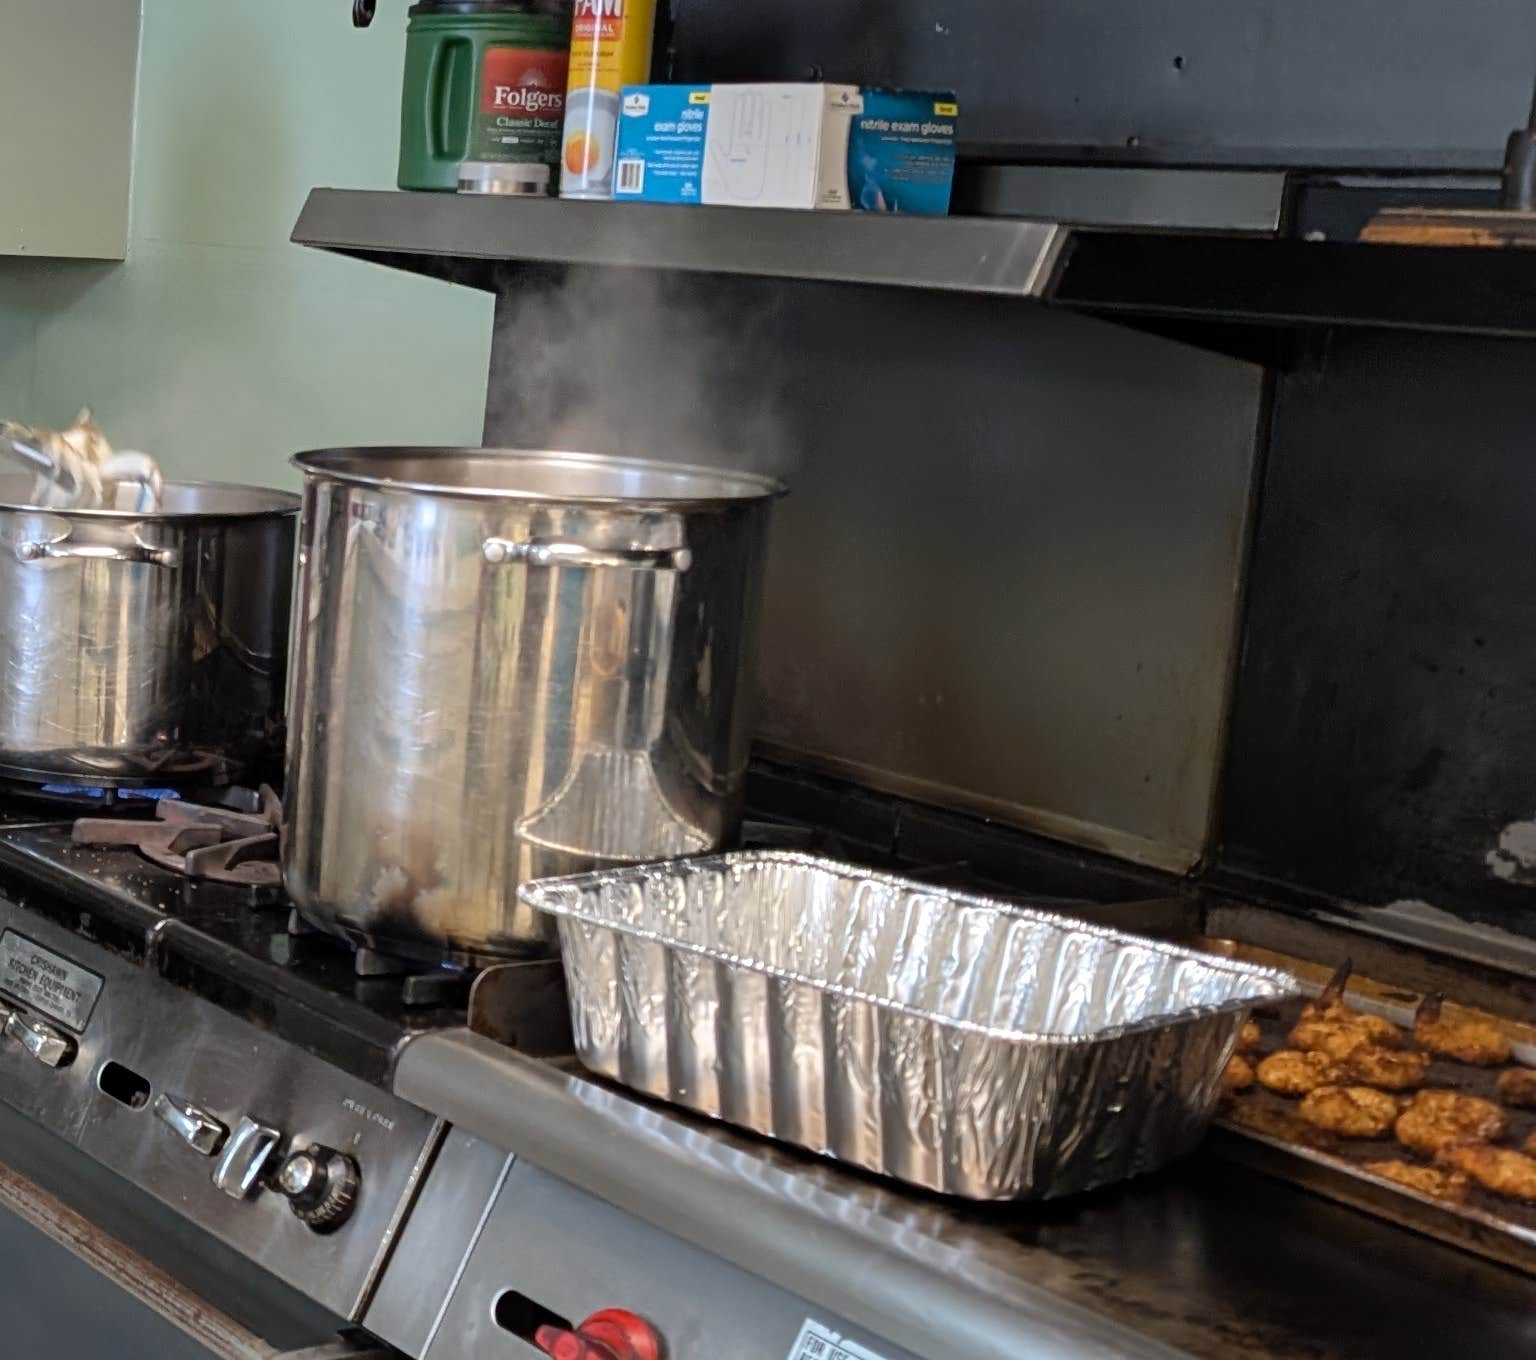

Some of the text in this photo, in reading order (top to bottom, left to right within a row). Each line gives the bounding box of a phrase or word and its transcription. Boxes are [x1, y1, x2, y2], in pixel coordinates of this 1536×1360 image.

[495, 86, 562, 112] Folgers
[891, 122, 919, 133] exam
[921, 122, 954, 135] gloves
